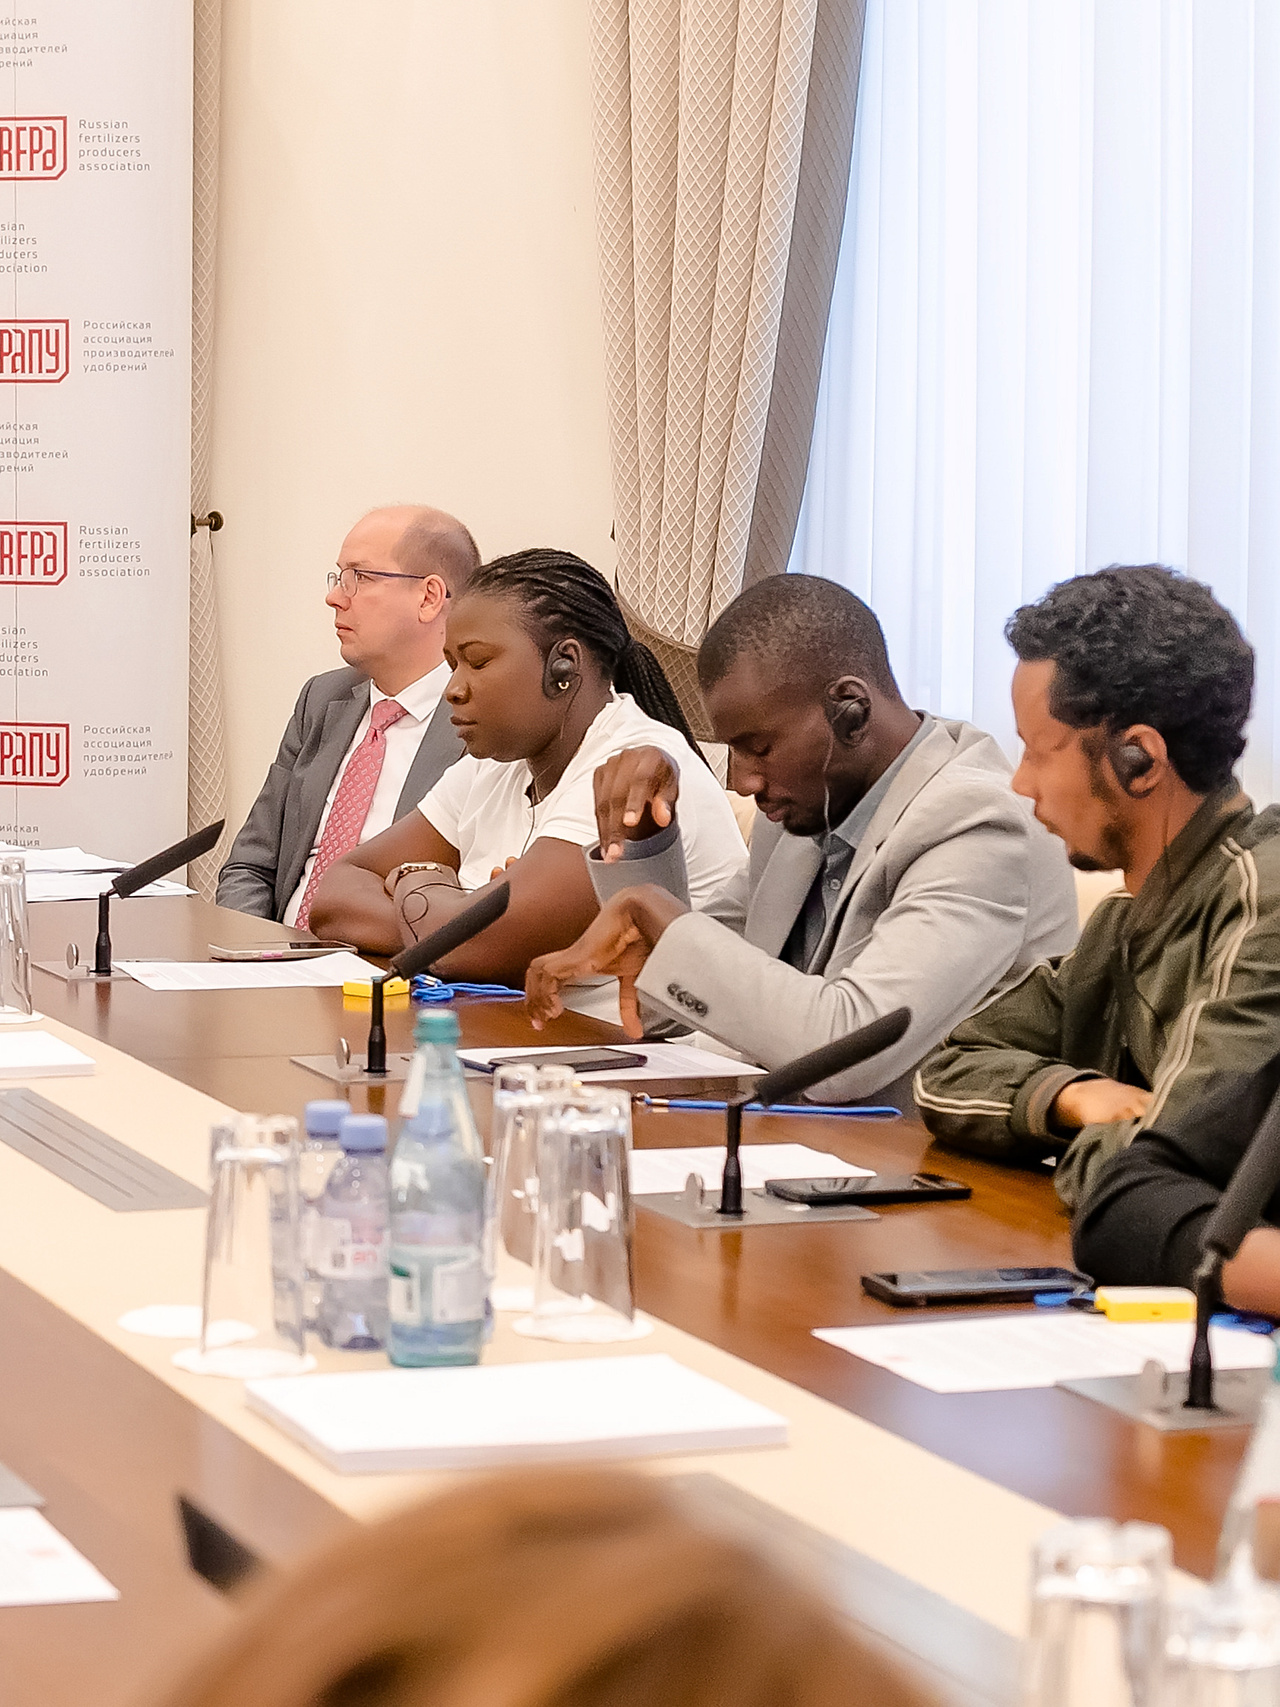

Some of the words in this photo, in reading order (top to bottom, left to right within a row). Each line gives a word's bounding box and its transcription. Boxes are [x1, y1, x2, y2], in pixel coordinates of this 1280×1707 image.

[78, 118, 129, 130] Russian
[78, 132, 141, 144] fertilizers
[78, 146, 142, 160] producers
[78, 160, 151, 172] association
[83, 319, 152, 330] Российская
[82, 335, 153, 345] ассоциация
[82, 348, 175, 360] производителей
[82, 361, 148, 374] удобрений
[79, 524, 129, 536] Russian
[78, 538, 141, 550] fertilizers
[78, 552, 142, 565] producers
[78, 566, 151, 578] association
[83, 724, 151, 735] Российская
[82, 739, 152, 749] ассоциация
[82, 765, 147, 778] удобрений
